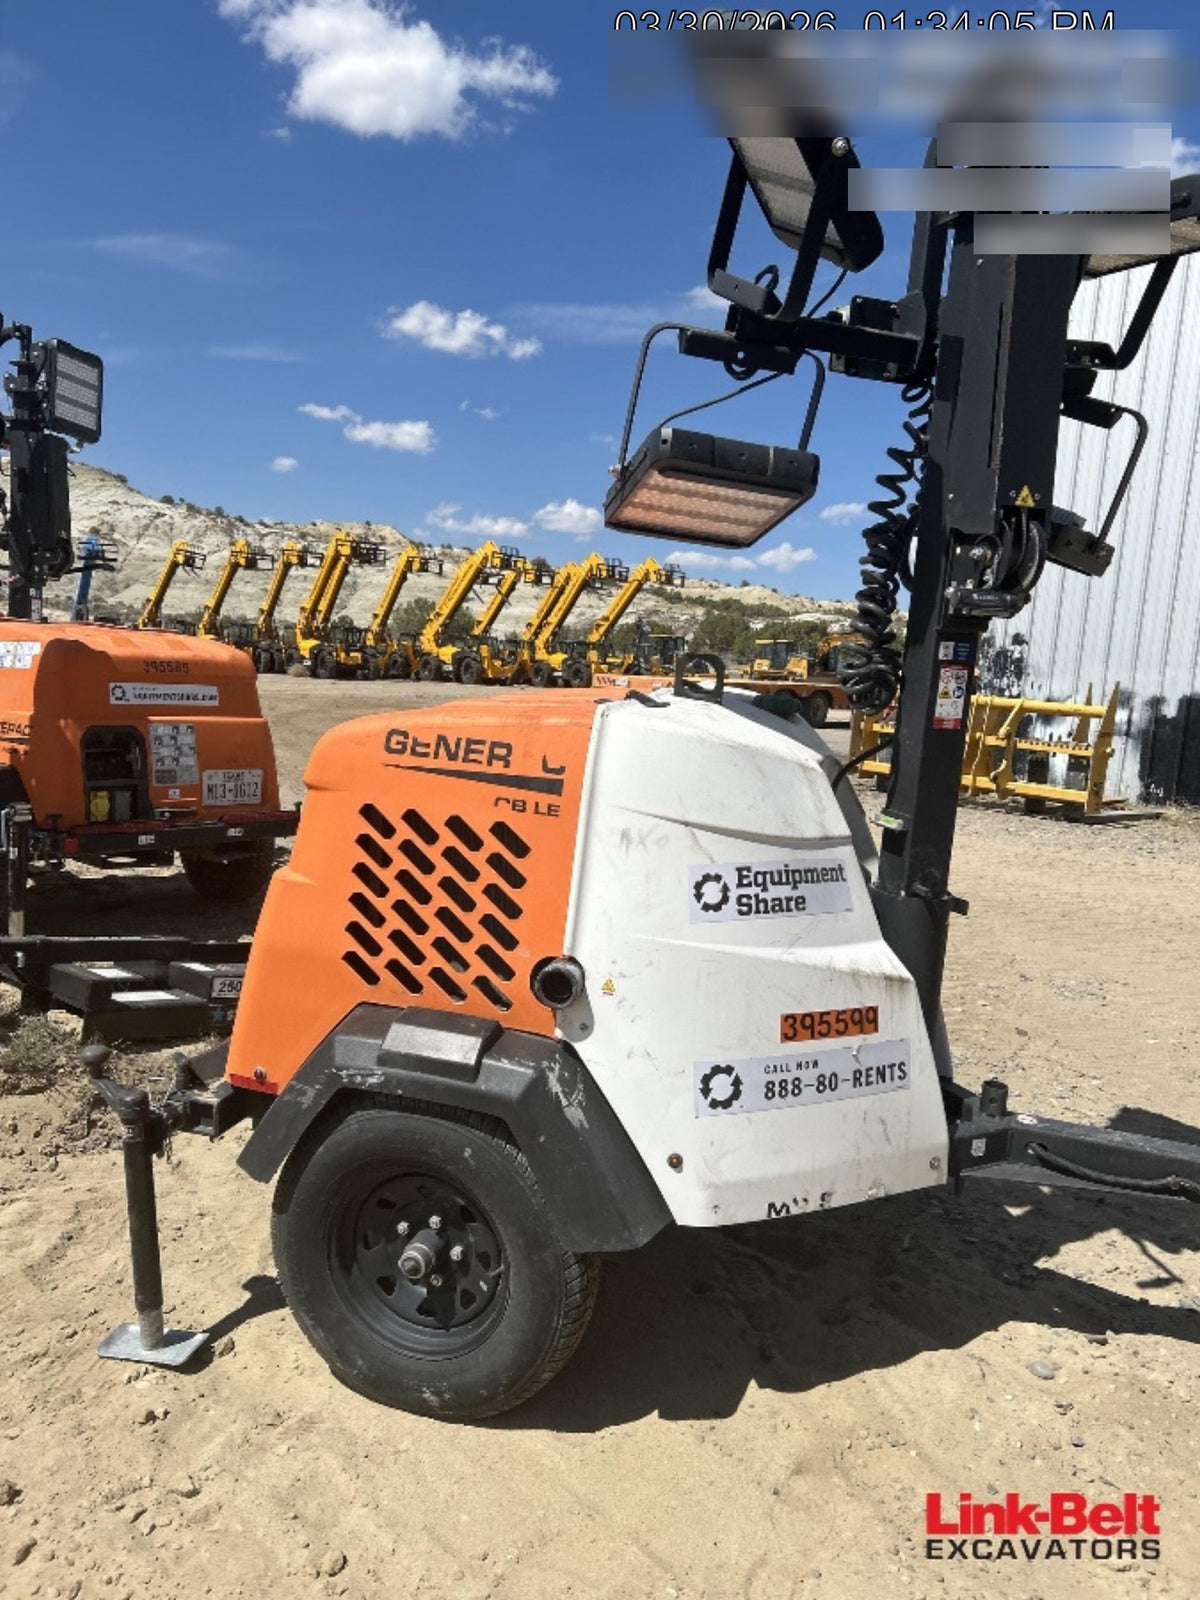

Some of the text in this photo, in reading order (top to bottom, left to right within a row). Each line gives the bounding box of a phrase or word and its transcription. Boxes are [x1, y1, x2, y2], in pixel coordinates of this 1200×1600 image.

[735, 864, 847, 892] Equipment
[736, 893, 806, 916] Share
[783, 1007, 878, 1041] 395599
[764, 1059, 819, 1075] CALL NOW
[764, 1061, 908, 1101] 888-80-RENTS
